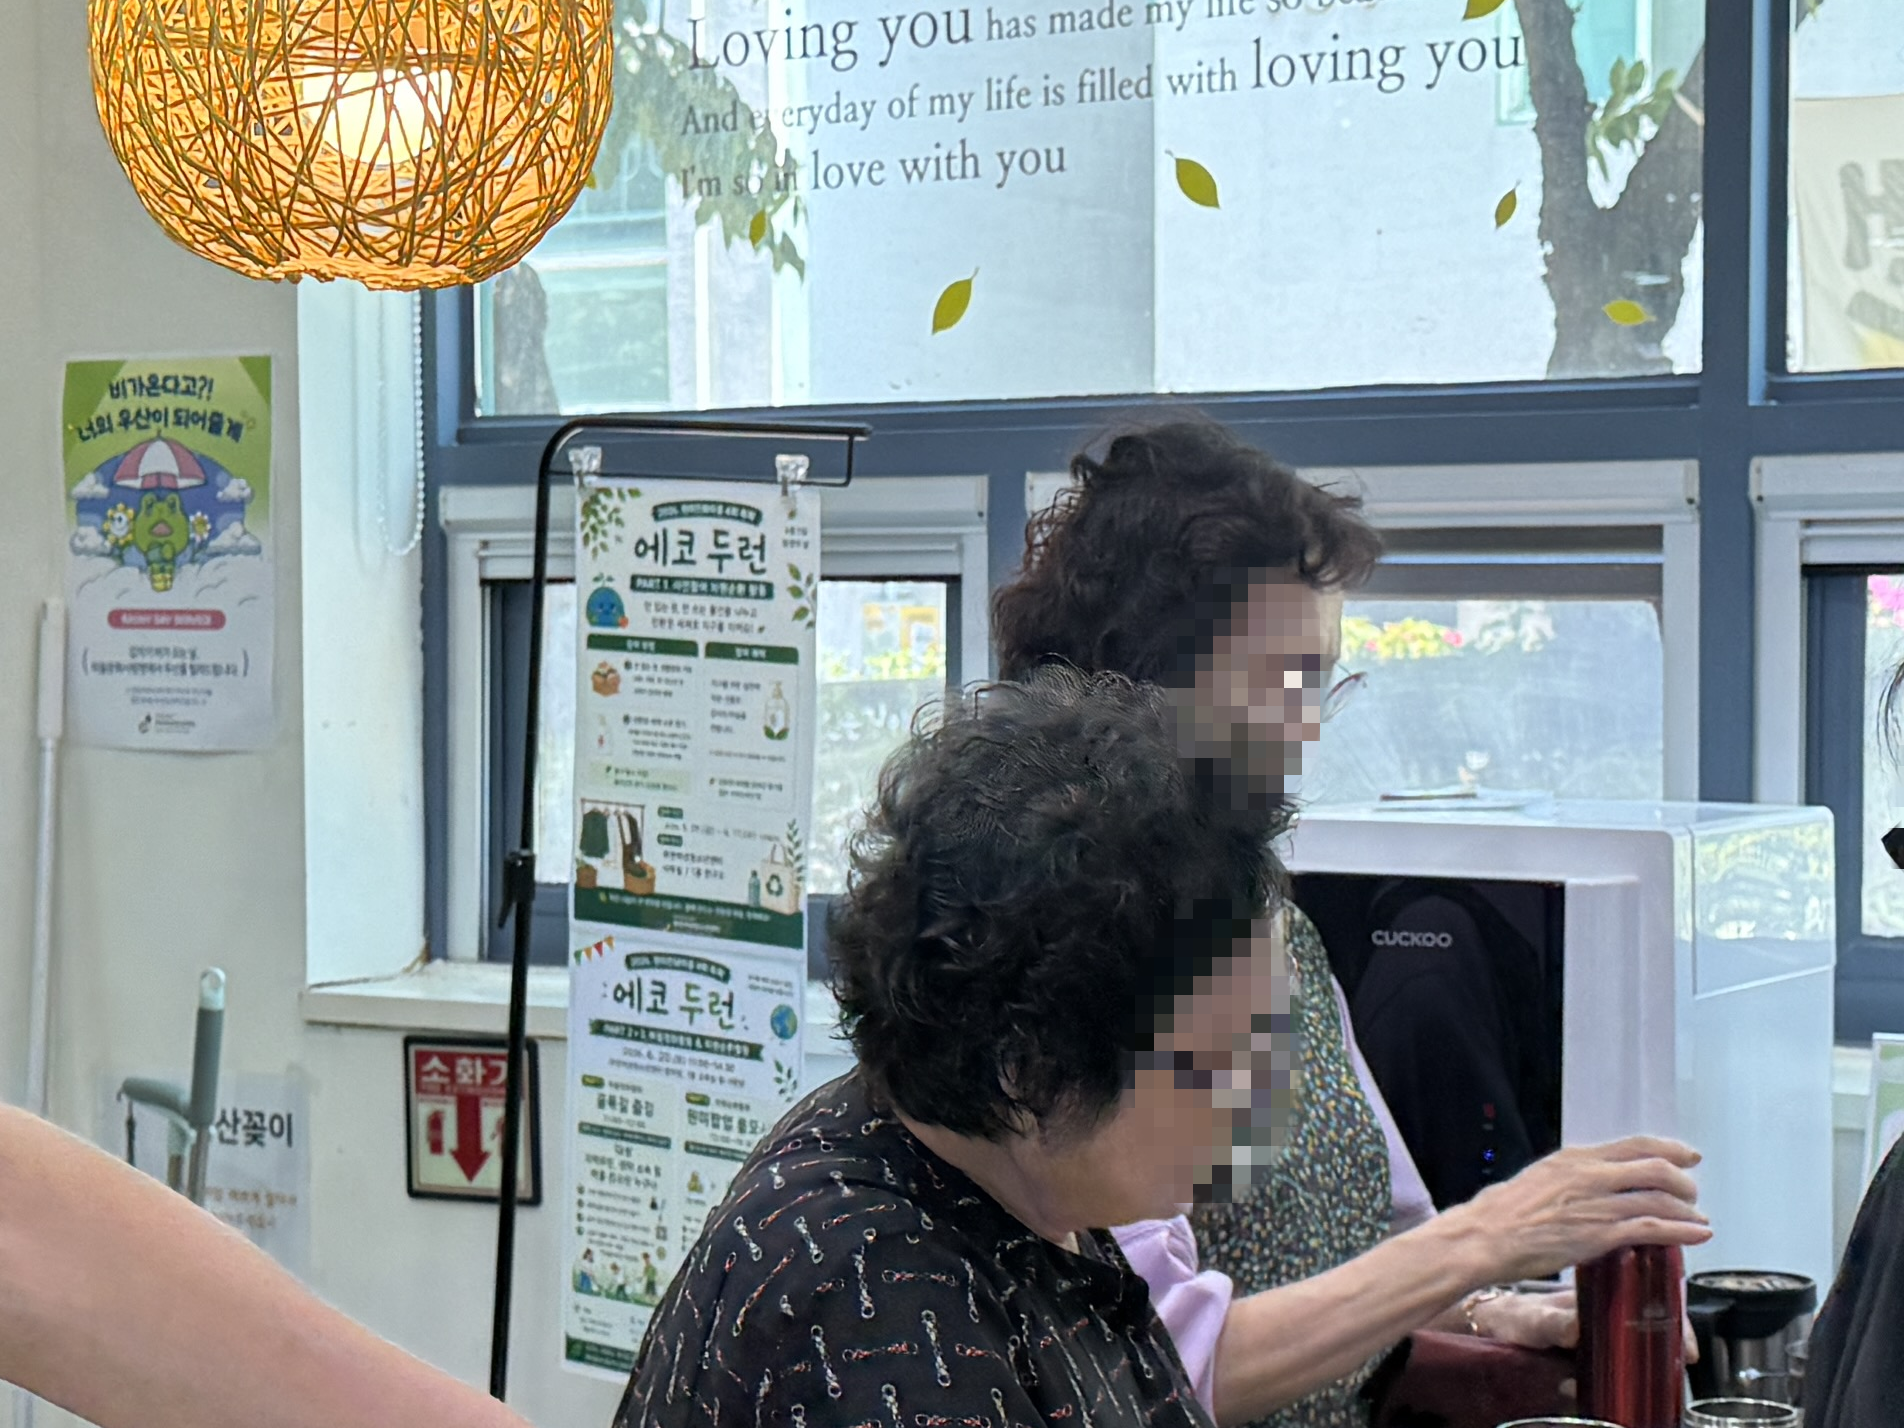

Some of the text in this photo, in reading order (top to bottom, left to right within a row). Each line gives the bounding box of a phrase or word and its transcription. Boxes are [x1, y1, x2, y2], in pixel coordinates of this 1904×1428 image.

[687, 7, 859, 72] Loving
[879, 8, 974, 67] you
[987, 6, 1036, 42] has
[681, 100, 738, 136] And
[887, 82, 920, 119] of
[930, 84, 975, 127] my
[984, 74, 1032, 113] life
[1042, 74, 1066, 109] is
[1076, 63, 1154, 107] filled
[1166, 61, 1238, 100] with
[1251, 33, 1406, 93] loving
[1424, 34, 1525, 89] you
[733, 173, 764, 196] so
[775, 166, 798, 193] in
[811, 148, 886, 190] love
[899, 138, 982, 186] with
[995, 142, 1067, 194] you
[78, 407, 245, 443] 너의 우산이 되어줄게
[634, 527, 768, 576] 에코 두런
[1371, 929, 1453, 948] CUCKOO
[612, 975, 669, 1016] 에코
[679, 981, 736, 1030] 두런
[215, 1107, 293, 1148] 산꽂이
